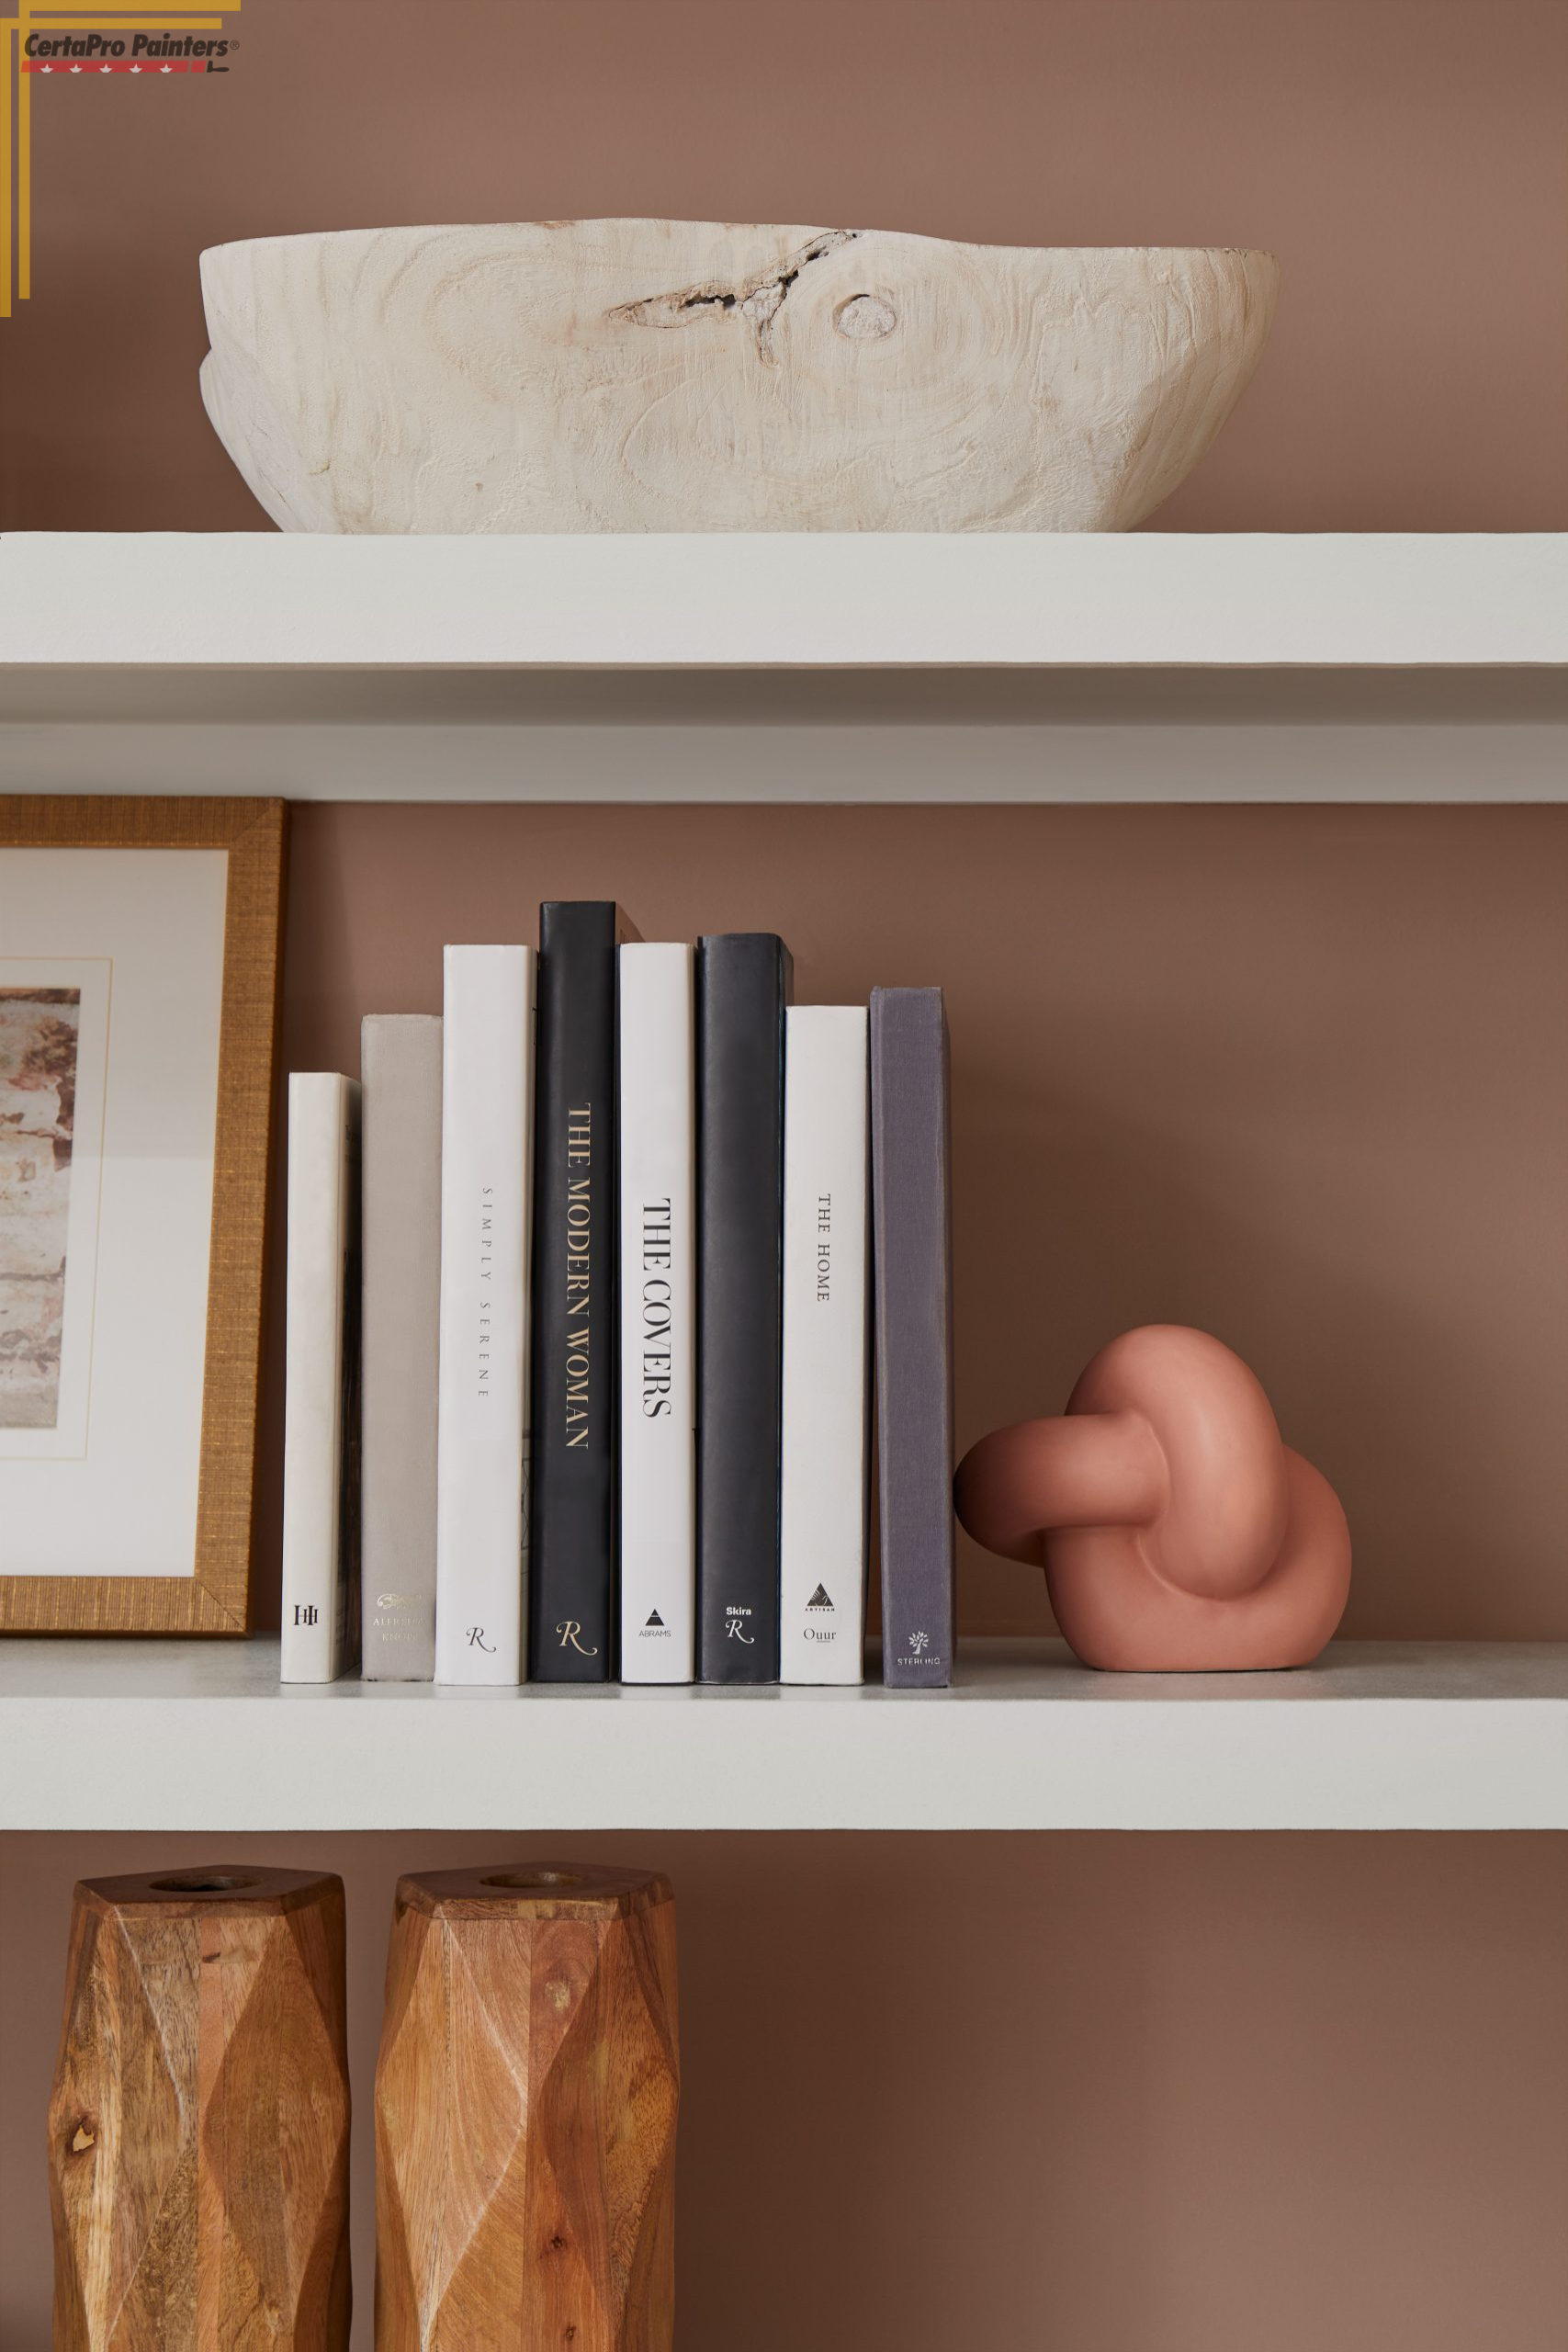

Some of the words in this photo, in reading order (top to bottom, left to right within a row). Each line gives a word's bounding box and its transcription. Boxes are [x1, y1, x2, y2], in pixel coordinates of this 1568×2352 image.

[568, 1102, 591, 1168] THE
[480, 1187, 493, 1281] SIMPLY
[644, 1198, 671, 1271] THE
[818, 1193, 830, 1232] THE
[566, 1177, 591, 1317] MODERN
[818, 1244, 829, 1301] HOME
[478, 1302, 491, 1396] SERENE
[643, 1280, 671, 1418] COVERS
[565, 1327, 590, 1450] WOMAN
[638, 1630, 671, 1638] ABRAMS
[726, 1620, 754, 1644] R
[727, 1606, 752, 1616] Skira
[804, 1628, 836, 1642] Ouur
[467, 1628, 496, 1652] R
[557, 1622, 597, 1655] R
[897, 1657, 941, 1666] STERLING
